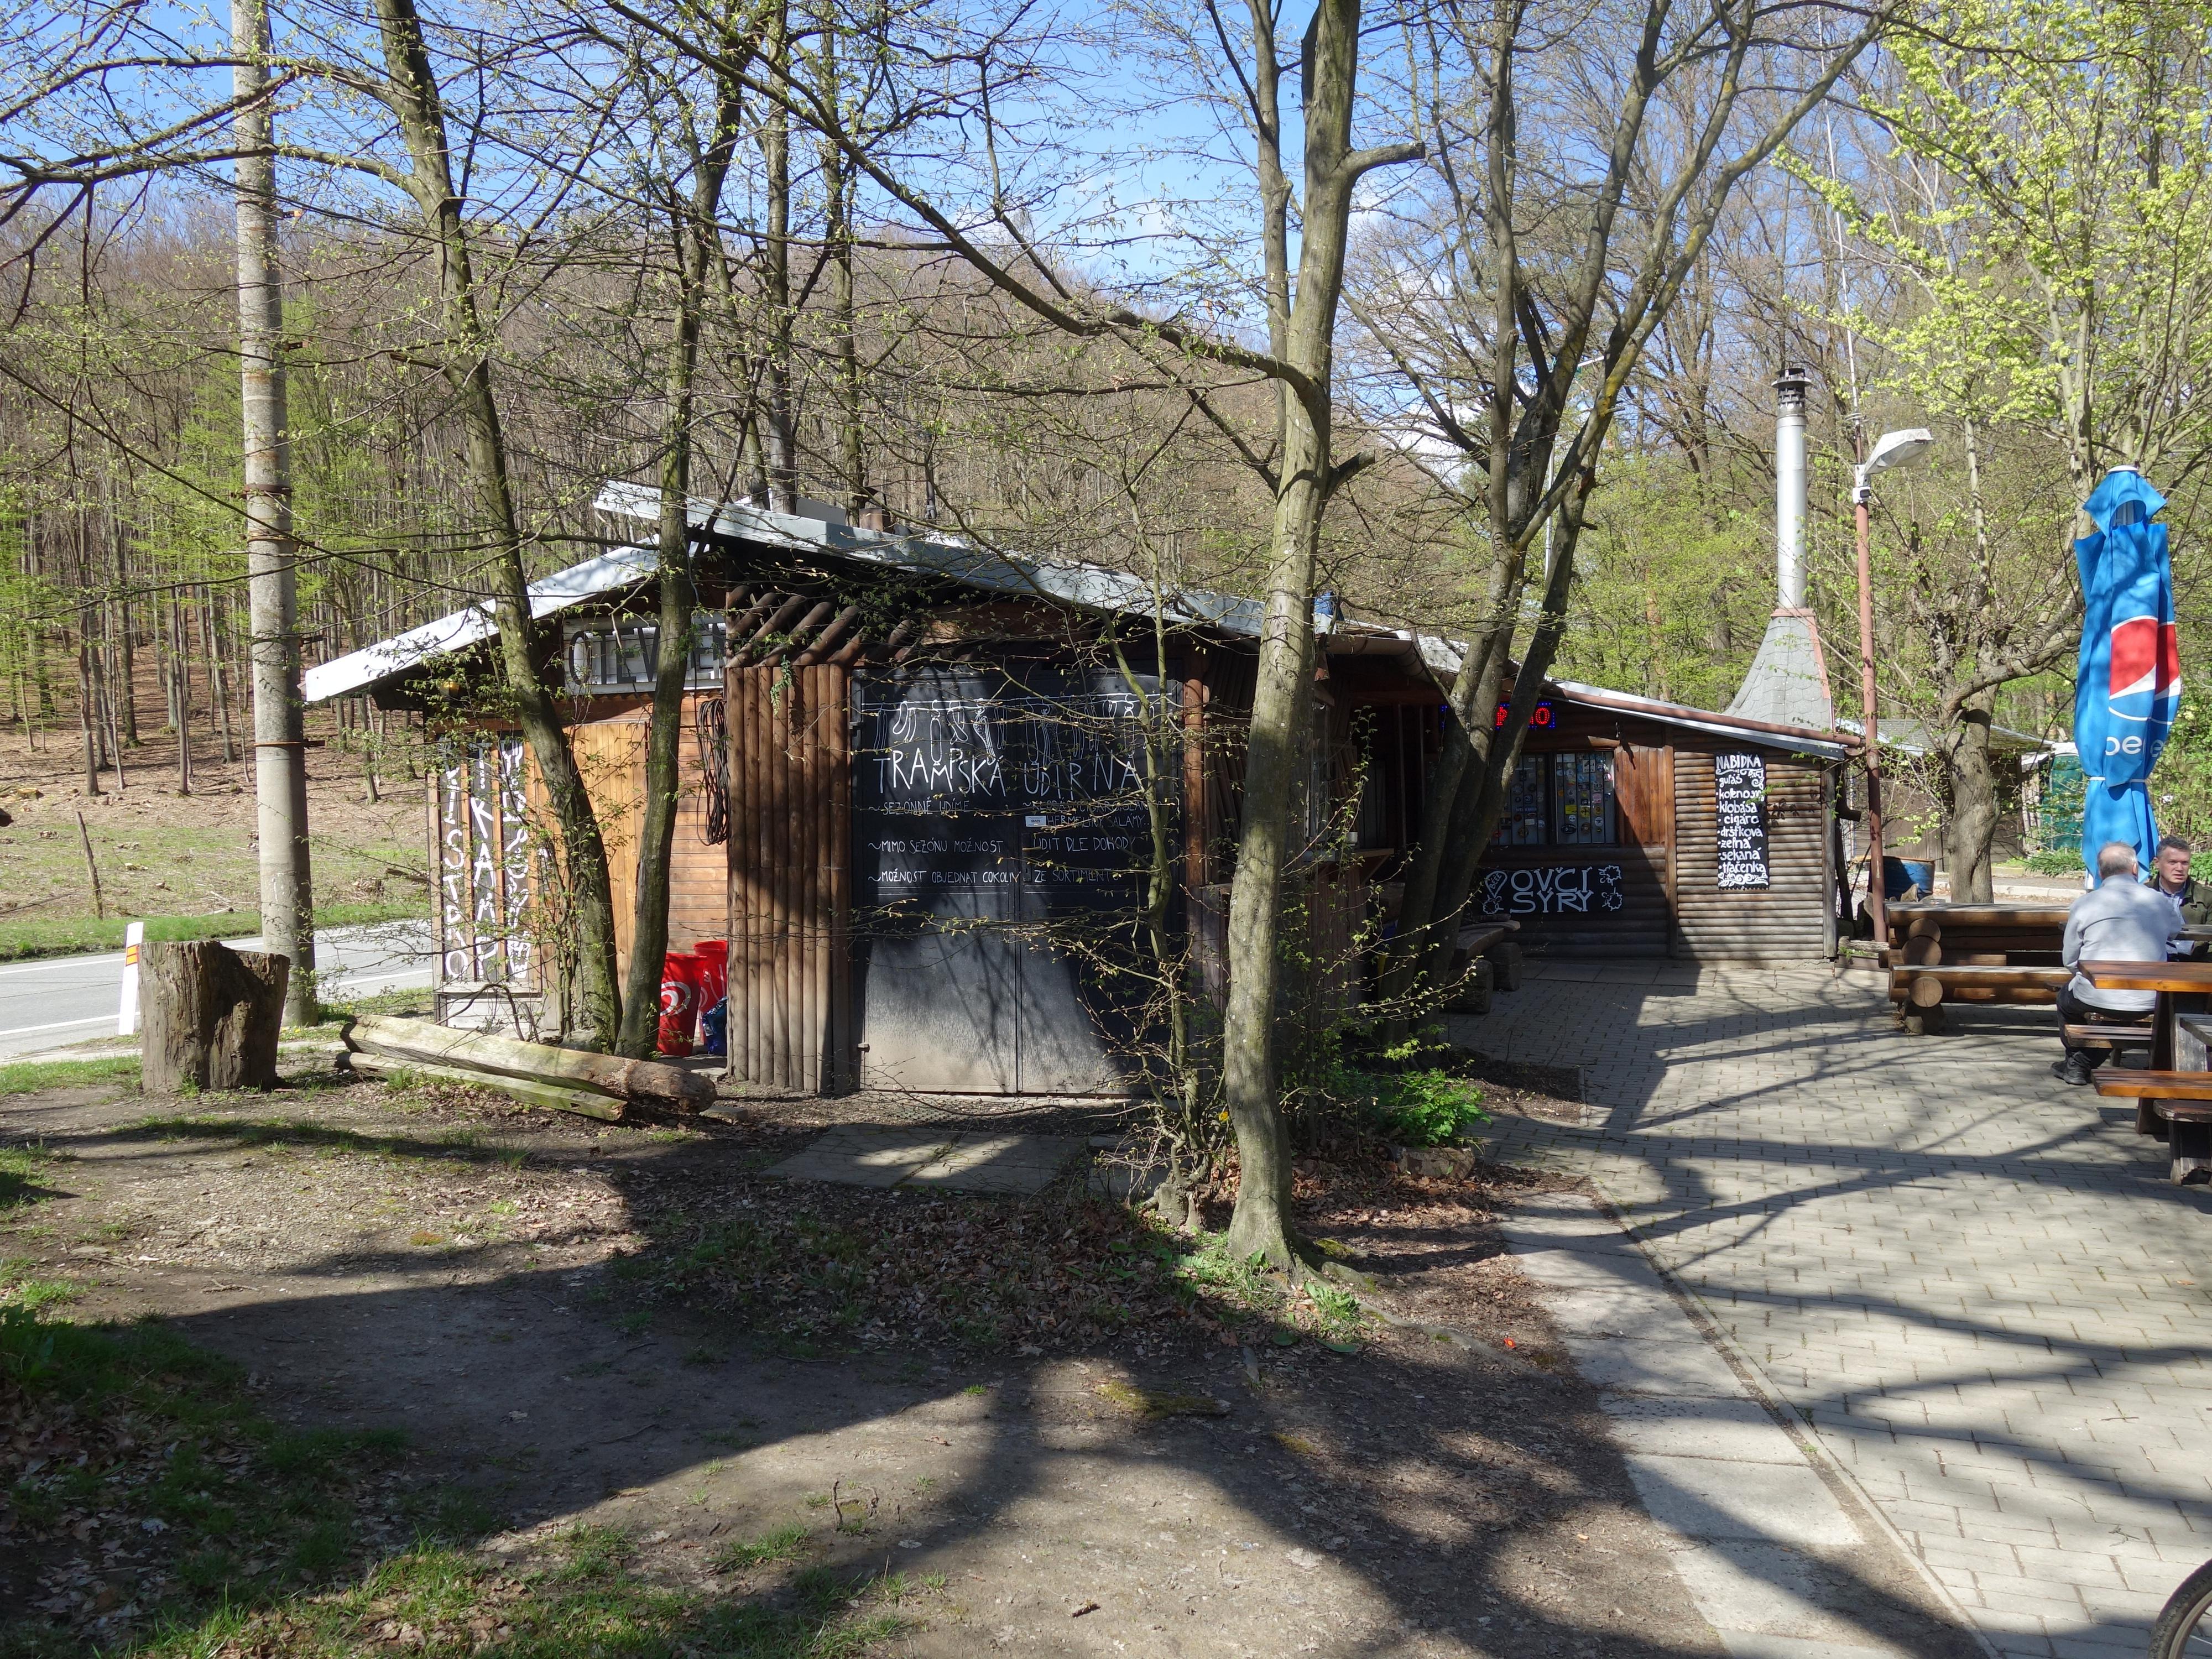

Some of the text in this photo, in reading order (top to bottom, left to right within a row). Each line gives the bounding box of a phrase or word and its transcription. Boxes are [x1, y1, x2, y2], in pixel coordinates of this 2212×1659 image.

[1716, 753, 1761, 769] NABÍDKA
[873, 748, 1006, 796] TRAMPSKÁ
[1719, 774, 1743, 787] guláš
[1719, 800, 1757, 813] klobása
[1724, 813, 1759, 826] cigáro
[881, 840, 906, 853] MIMO
[1066, 837, 1088, 852] DLE
[1721, 837, 1751, 849] zelná
[1720, 847, 1761, 860] sekaná
[1723, 861, 1766, 873] tlačenka
[931, 872, 977, 883] OBJEDNAT
[1034, 870, 1047, 883] ZE
[1510, 888, 1594, 914] SÝRY
